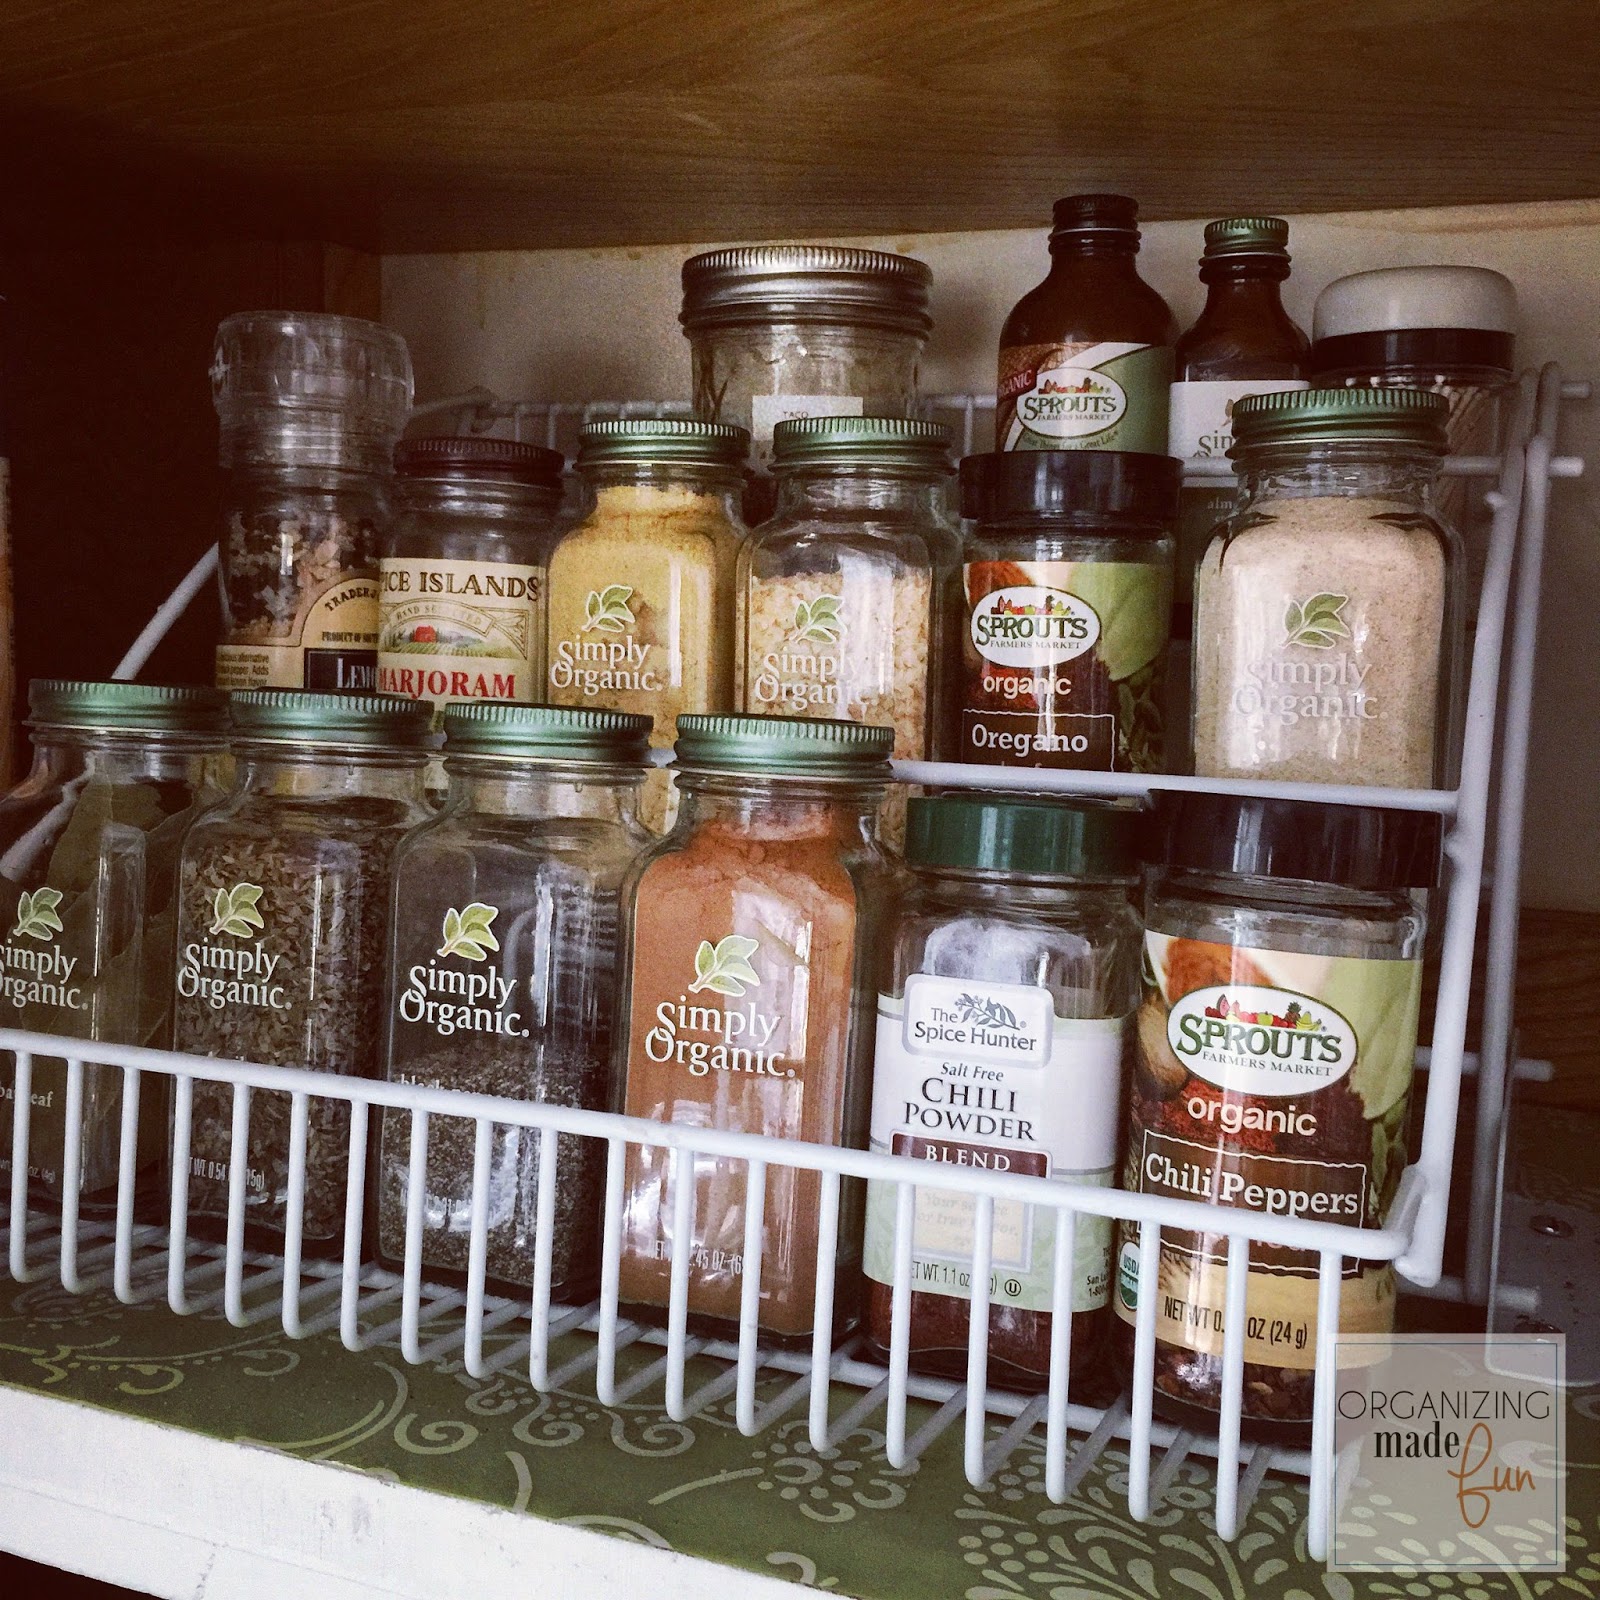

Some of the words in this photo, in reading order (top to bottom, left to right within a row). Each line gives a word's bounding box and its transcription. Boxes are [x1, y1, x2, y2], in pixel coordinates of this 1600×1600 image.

[783, 411, 809, 419] TACO
[1023, 396, 1117, 421] SPROUTS
[1037, 413, 1073, 422] FARMERS
[1075, 413, 1112, 421] MARKET
[1198, 430, 1234, 454] Sim
[1207, 496, 1233, 509] alm
[324, 587, 371, 612] TRADER
[380, 571, 411, 592] ICE
[420, 571, 541, 601] ISLANDS
[975, 614, 1089, 646] SPROUTS
[990, 640, 1033, 649] FARMERS
[1035, 640, 1082, 649] MARKET
[558, 634, 651, 669] Simply
[763, 645, 858, 683] Simply
[378, 667, 516, 699] MARJORAM
[982, 674, 1072, 700] organic
[1243, 652, 1373, 694] Simply
[971, 723, 1089, 758] Oregano
[184, 937, 281, 983] Simply
[409, 959, 518, 1009] Simply
[656, 995, 781, 1047] Simply
[931, 1007, 959, 1024] The
[914, 1021, 966, 1043] Spice
[971, 1027, 1037, 1051] Hunter
[1176, 1012, 1343, 1064] SPROUTS
[941, 1061, 967, 1078] Salt
[973, 1065, 1004, 1082] Free
[1202, 1050, 1266, 1070] FARMERS
[1270, 1062, 1333, 1077] MARKET
[30, 1090, 54, 1108] eaf
[921, 1078, 1018, 1113] CHILI
[902, 1101, 1036, 1142] POWDER
[1187, 1096, 1317, 1137] organic
[924, 1144, 1011, 1172] BLEND
[1145, 1152, 1213, 1198] Chili
[1220, 1171, 1359, 1218] Peppers
[943, 1267, 957, 1285] 1.1
[1165, 1296, 1186, 1322] NET
[1189, 1305, 1211, 1330] WT
[1247, 1317, 1265, 1341] OZ
